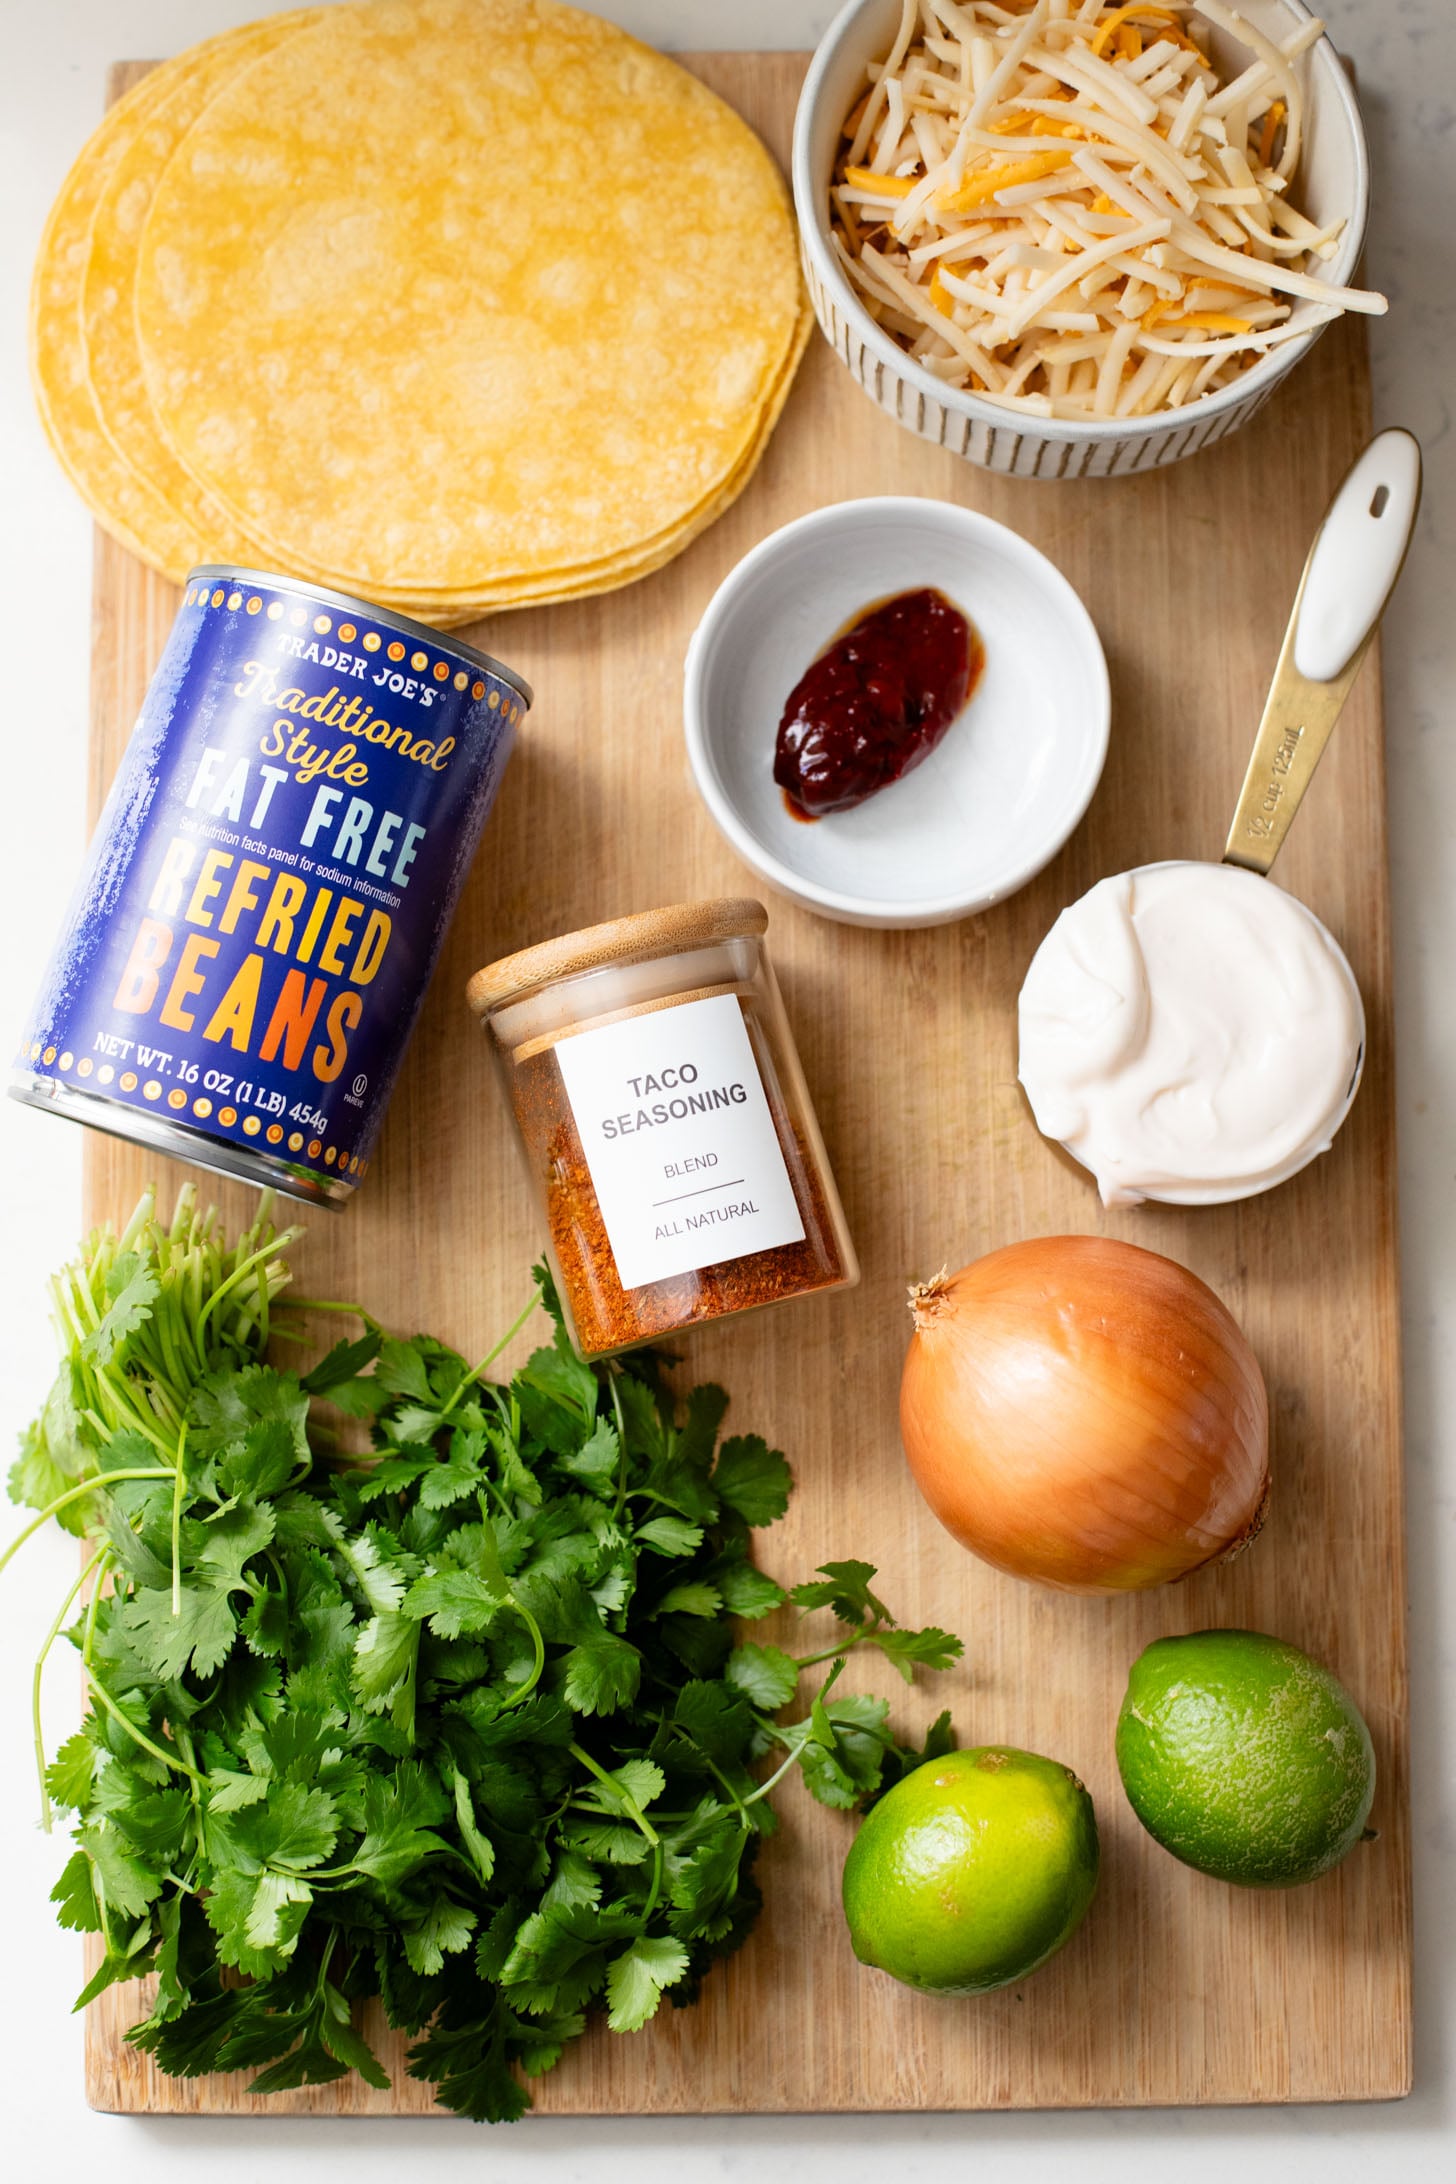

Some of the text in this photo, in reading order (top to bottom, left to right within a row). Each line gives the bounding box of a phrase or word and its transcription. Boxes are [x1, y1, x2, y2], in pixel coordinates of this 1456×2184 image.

[278, 633, 438, 707] TRADER JOE'S
[234, 661, 456, 771] Traditional
[1272, 724, 1304, 776] 125mL
[260, 719, 369, 787] Style
[184, 748, 426, 888] FAT FREE
[1263, 781, 1284, 812] cup
[180, 816, 401, 909] See nutrition facts panel for sodium information
[147, 837, 392, 986] REFRIED
[113, 917, 363, 1083] BEANS
[93, 1032, 328, 1135] NET WT. 16 OZ (1 LB) 454g
[601, 1083, 747, 1139] SEASONING
[627, 1064, 698, 1097] TACO
[664, 1152, 718, 1178] BLEND
[655, 1200, 759, 1240] ALL NATURAL
